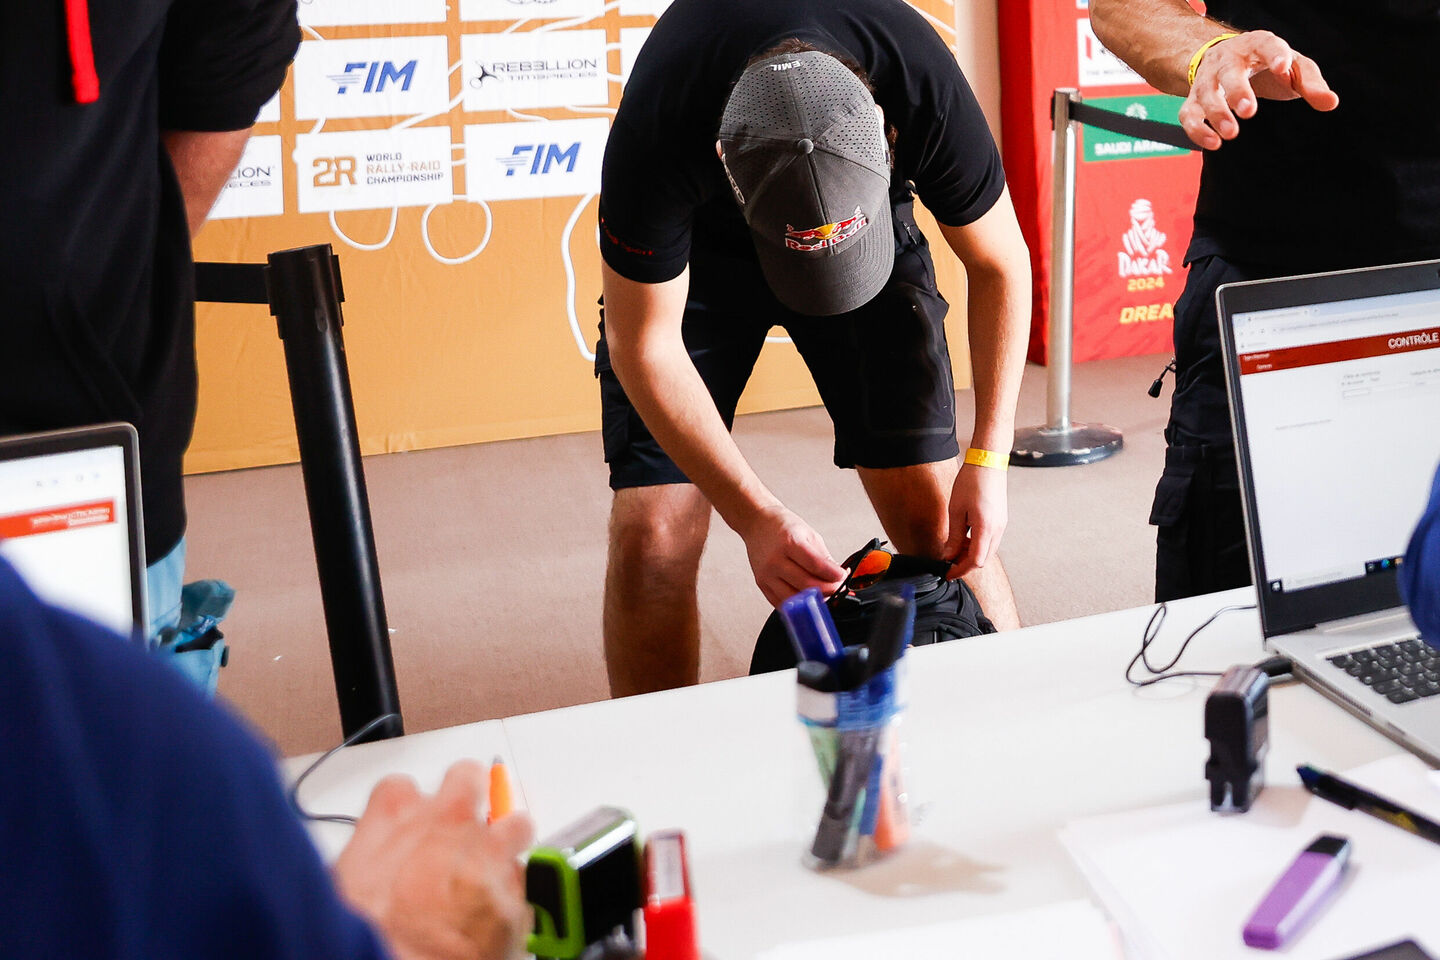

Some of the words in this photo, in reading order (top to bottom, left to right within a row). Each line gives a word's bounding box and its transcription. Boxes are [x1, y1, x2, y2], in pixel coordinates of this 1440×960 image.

[770, 60, 801, 71] EMIL
[332, 59, 418, 95] FIM
[366, 152, 402, 161] WORLD
[1094, 141, 1132, 157] SAUDI
[501, 141, 581, 176] FIM
[366, 160, 441, 174] RALLY-RAID
[367, 172, 444, 184] CHAMPIONSHIP
[785, 237, 828, 251] Red
[829, 216, 867, 246] Bull
[1117, 248, 1173, 278] DAKAR
[1127, 276, 1165, 292] 2024
[1388, 332, 1440, 350] CONTRÔLE
